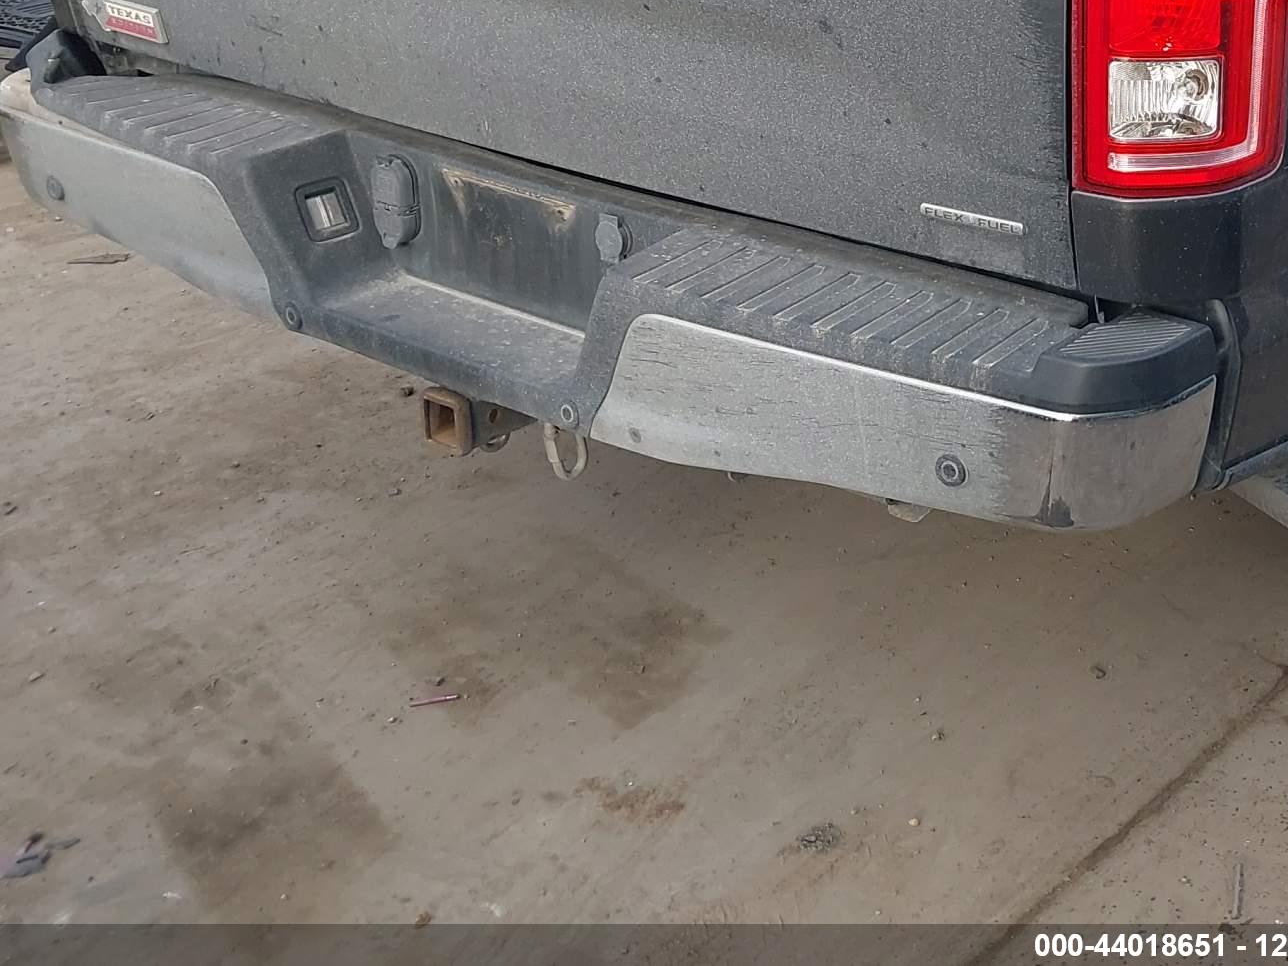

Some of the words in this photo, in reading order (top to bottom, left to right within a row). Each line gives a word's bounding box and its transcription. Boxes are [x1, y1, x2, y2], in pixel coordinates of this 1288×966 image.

[106, 4, 151, 25] TEXAS
[924, 206, 964, 223] FLEX
[977, 217, 1022, 234] FUEL
